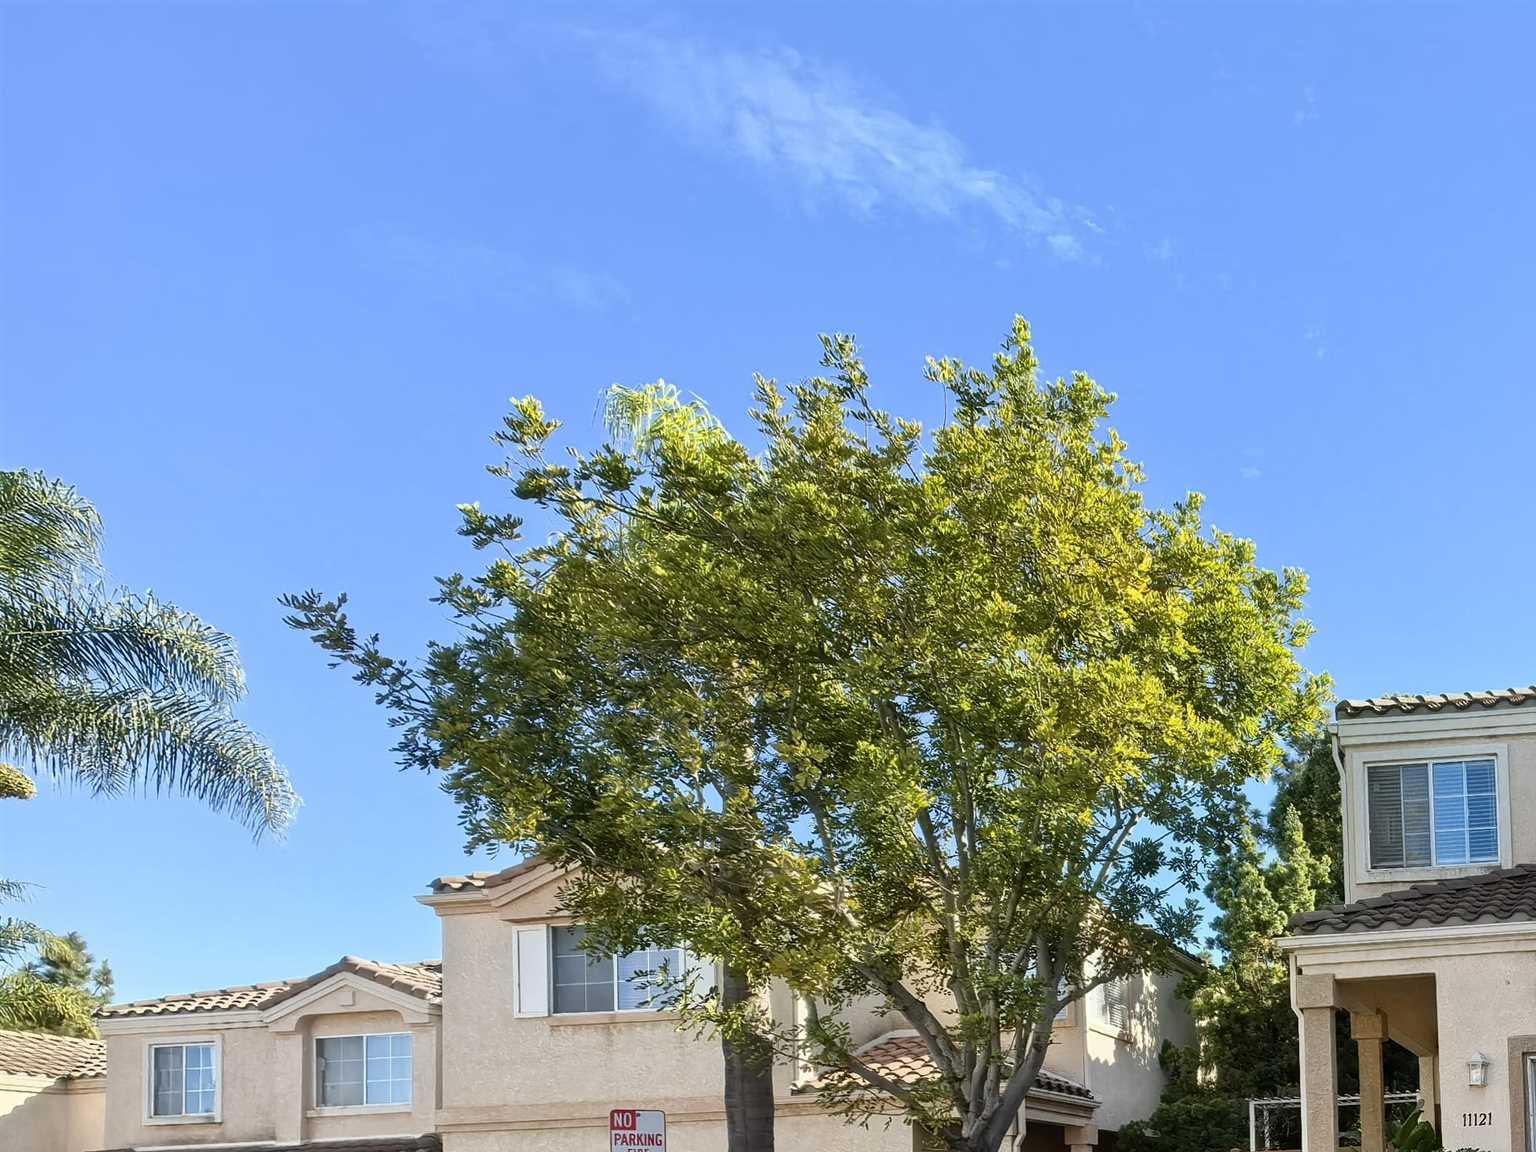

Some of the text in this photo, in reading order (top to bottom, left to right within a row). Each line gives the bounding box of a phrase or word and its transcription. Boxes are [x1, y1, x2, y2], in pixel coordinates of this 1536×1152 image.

[614, 1112, 632, 1128] NO
[1462, 1112, 1492, 1127] 11121
[614, 1133, 663, 1147] PARKING
